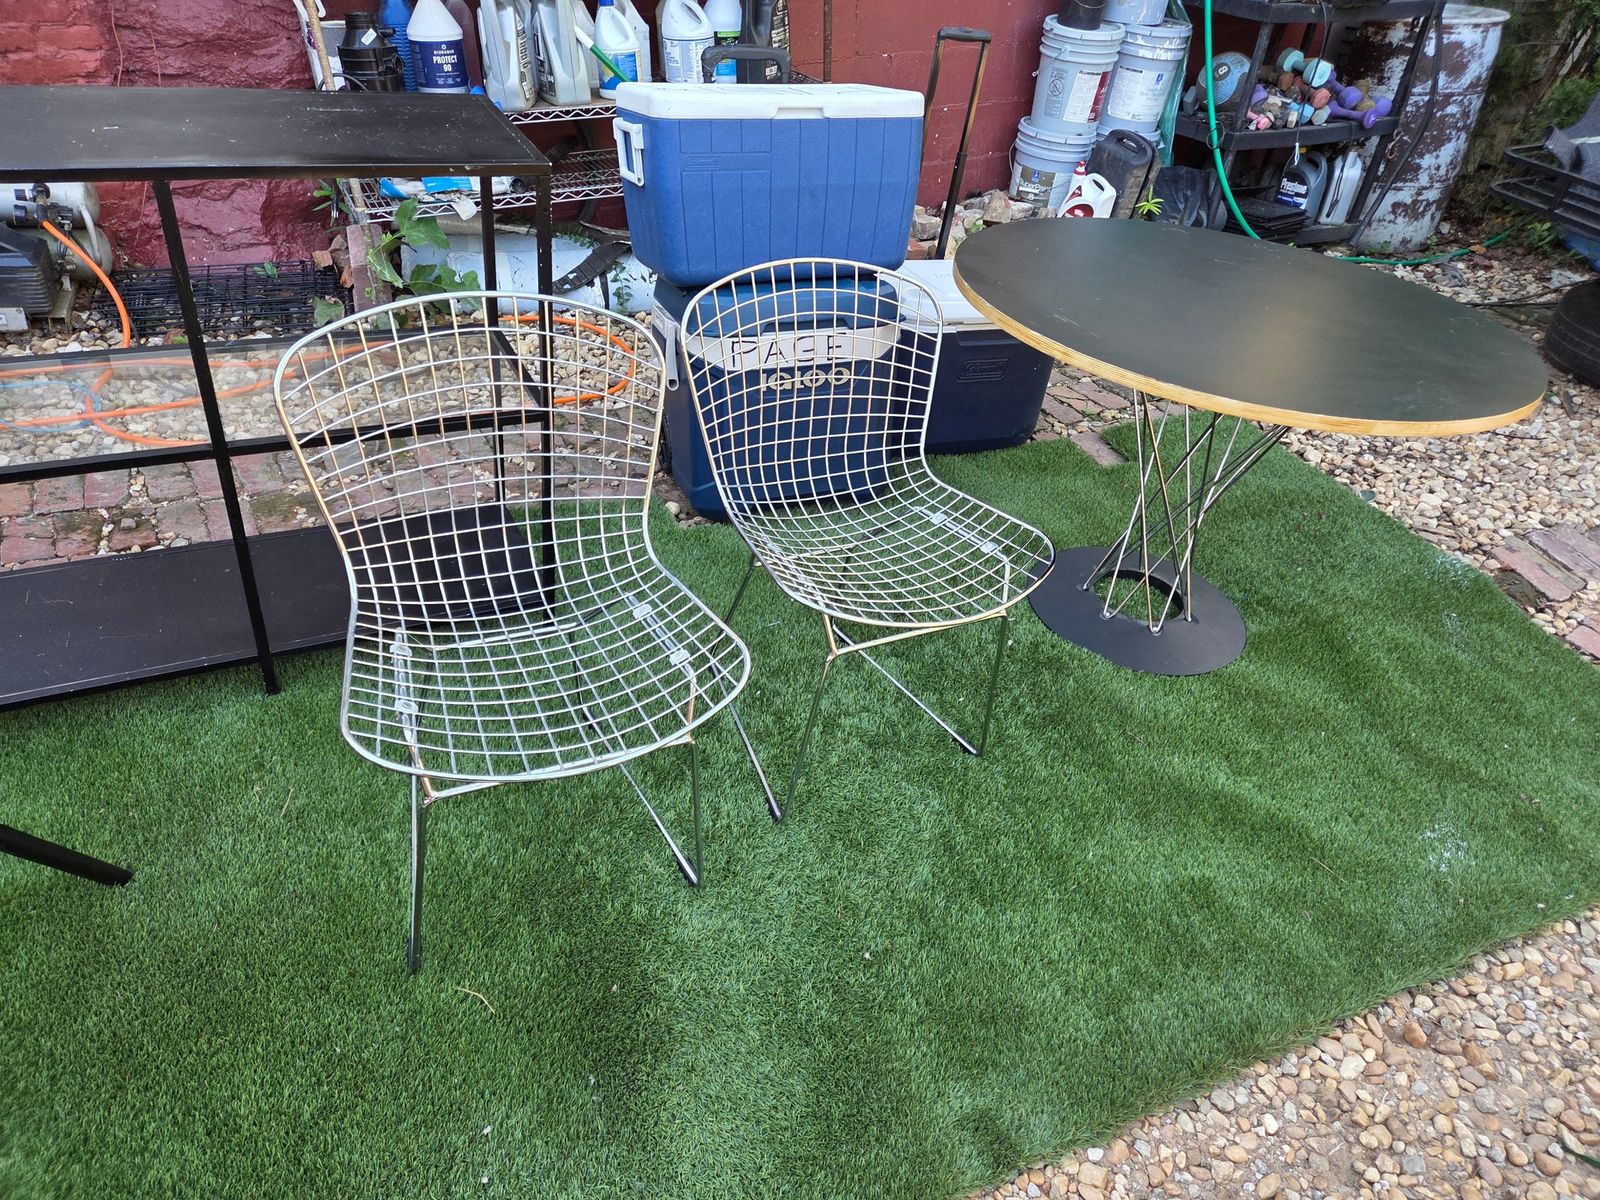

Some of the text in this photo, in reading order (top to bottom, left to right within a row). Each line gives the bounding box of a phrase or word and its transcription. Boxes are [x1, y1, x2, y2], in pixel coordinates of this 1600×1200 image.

[432, 55, 458, 64] PROTECT
[1280, 177, 1308, 194] Prestone
[731, 332, 847, 367] PAGE
